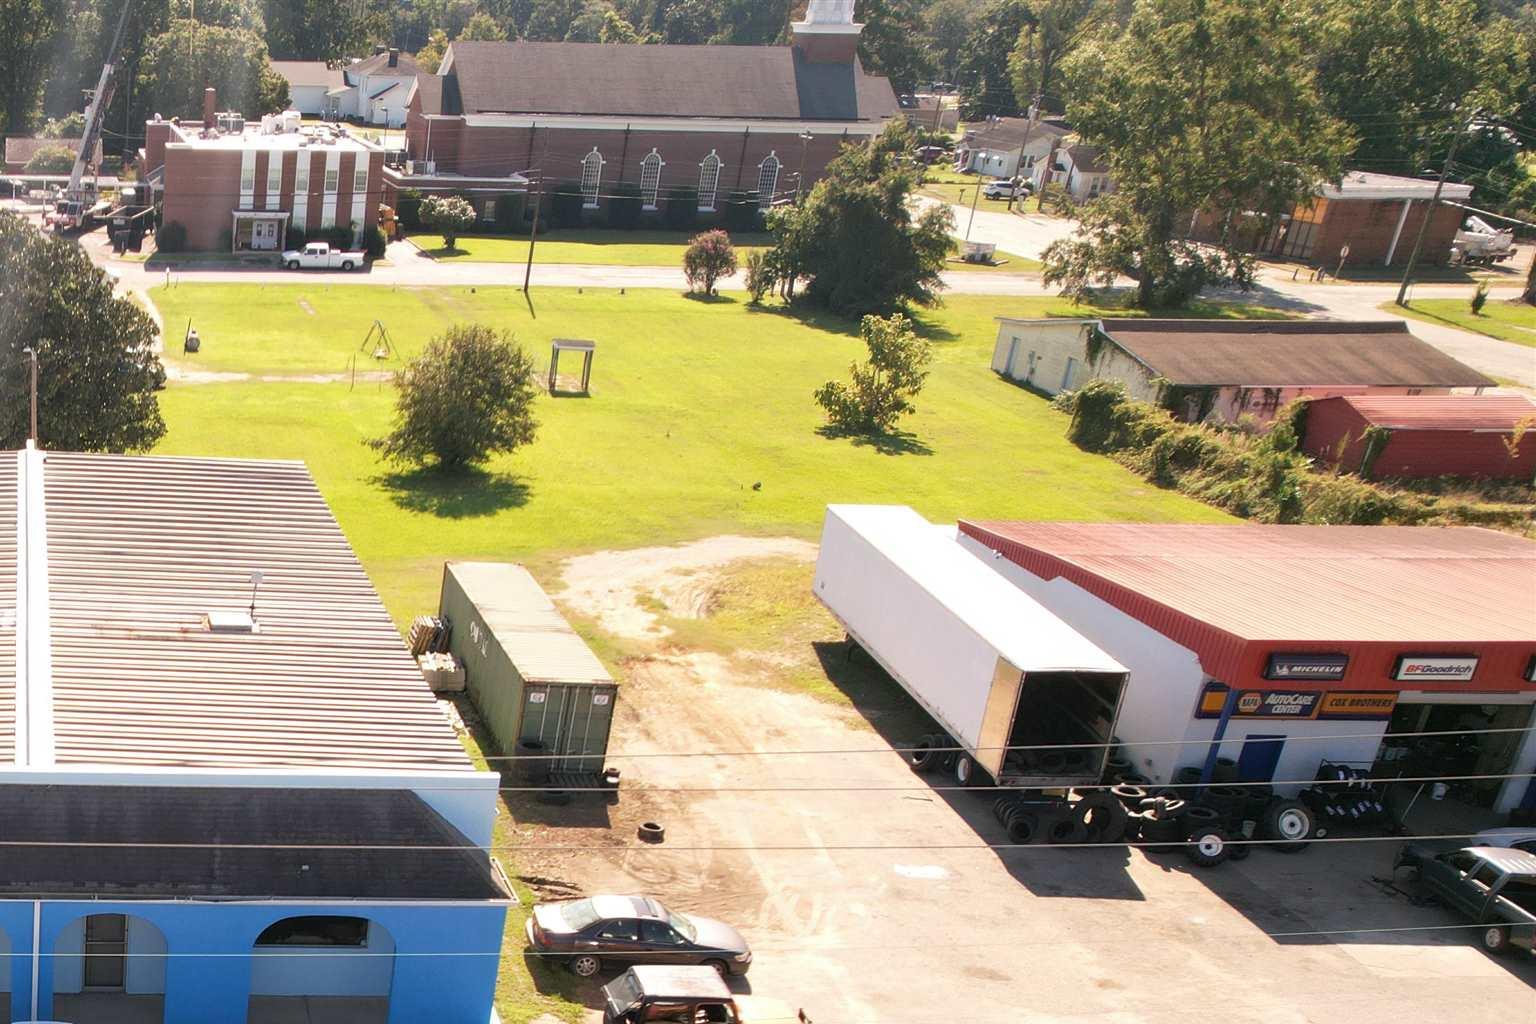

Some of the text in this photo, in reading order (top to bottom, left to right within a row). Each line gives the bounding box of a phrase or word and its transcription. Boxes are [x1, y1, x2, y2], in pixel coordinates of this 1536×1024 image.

[1291, 664, 1344, 673] MICHELIN
[1405, 663, 1472, 674] BFGoodrich
[1271, 705, 1302, 713] CENTER
